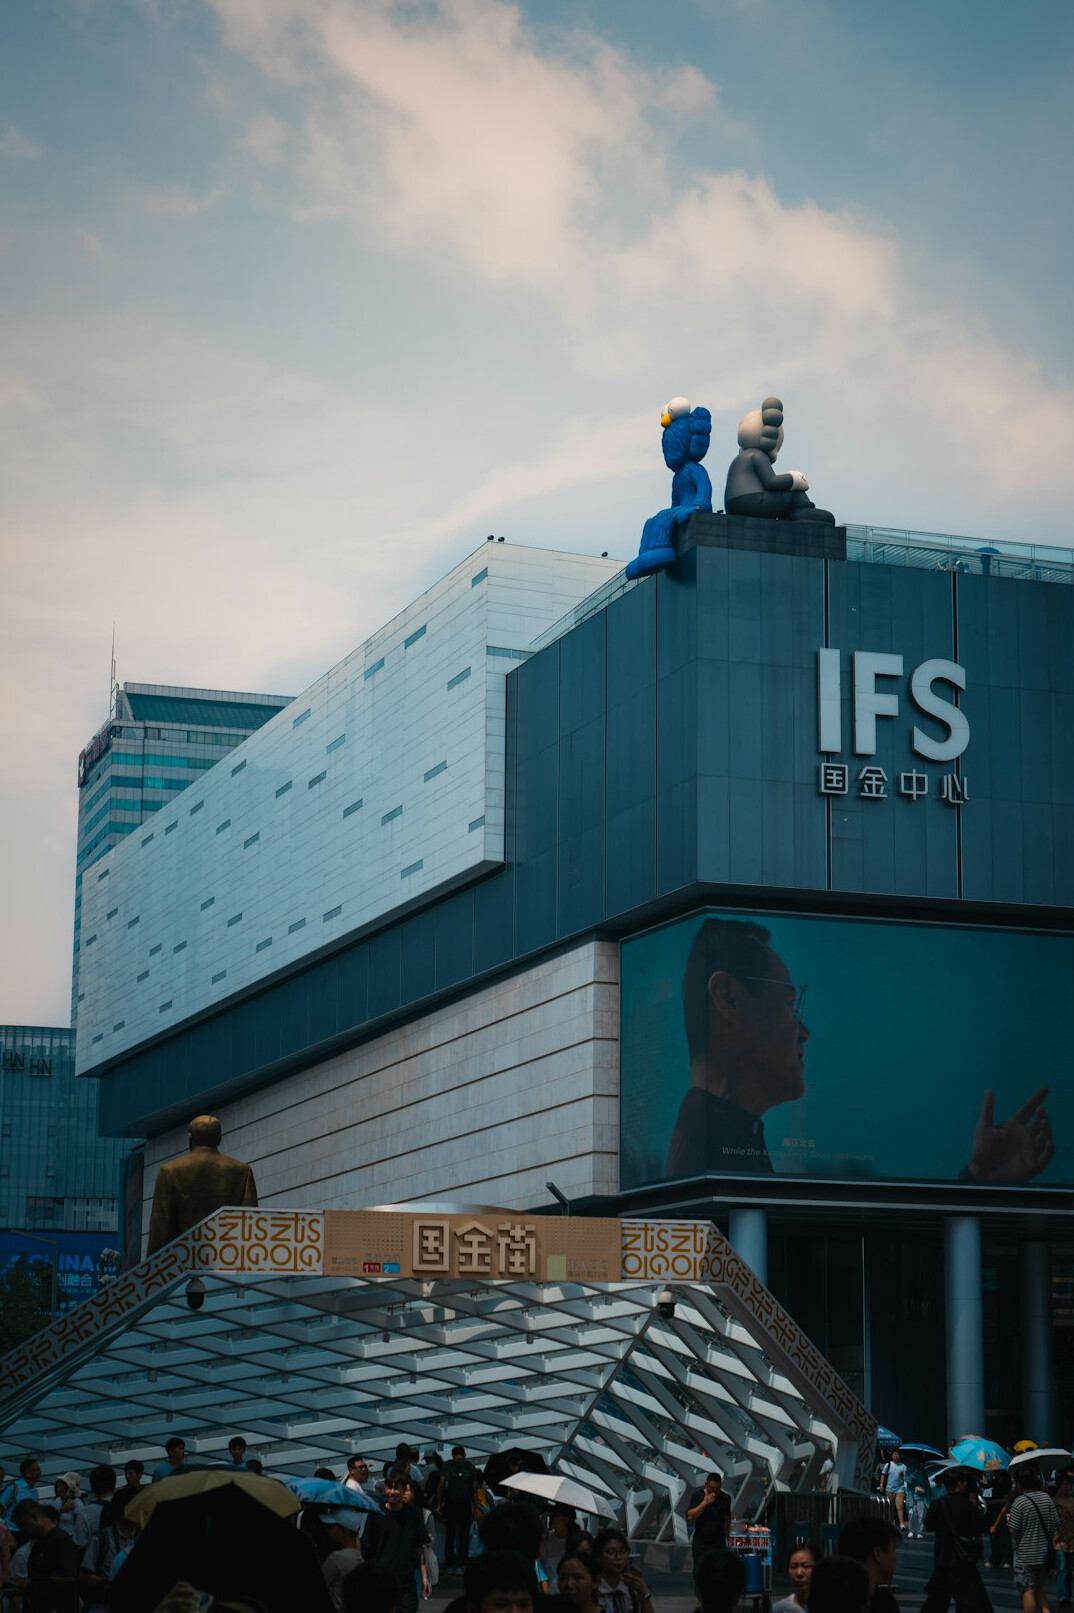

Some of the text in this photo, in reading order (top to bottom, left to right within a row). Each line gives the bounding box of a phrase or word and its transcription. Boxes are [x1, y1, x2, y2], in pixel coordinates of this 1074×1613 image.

[819, 647, 971, 762] IFS
[819, 763, 970, 804] 国金中心
[722, 1146, 745, 1156] While
[747, 1147, 761, 1156] the
[412, 1219, 537, 1274] 国金街
